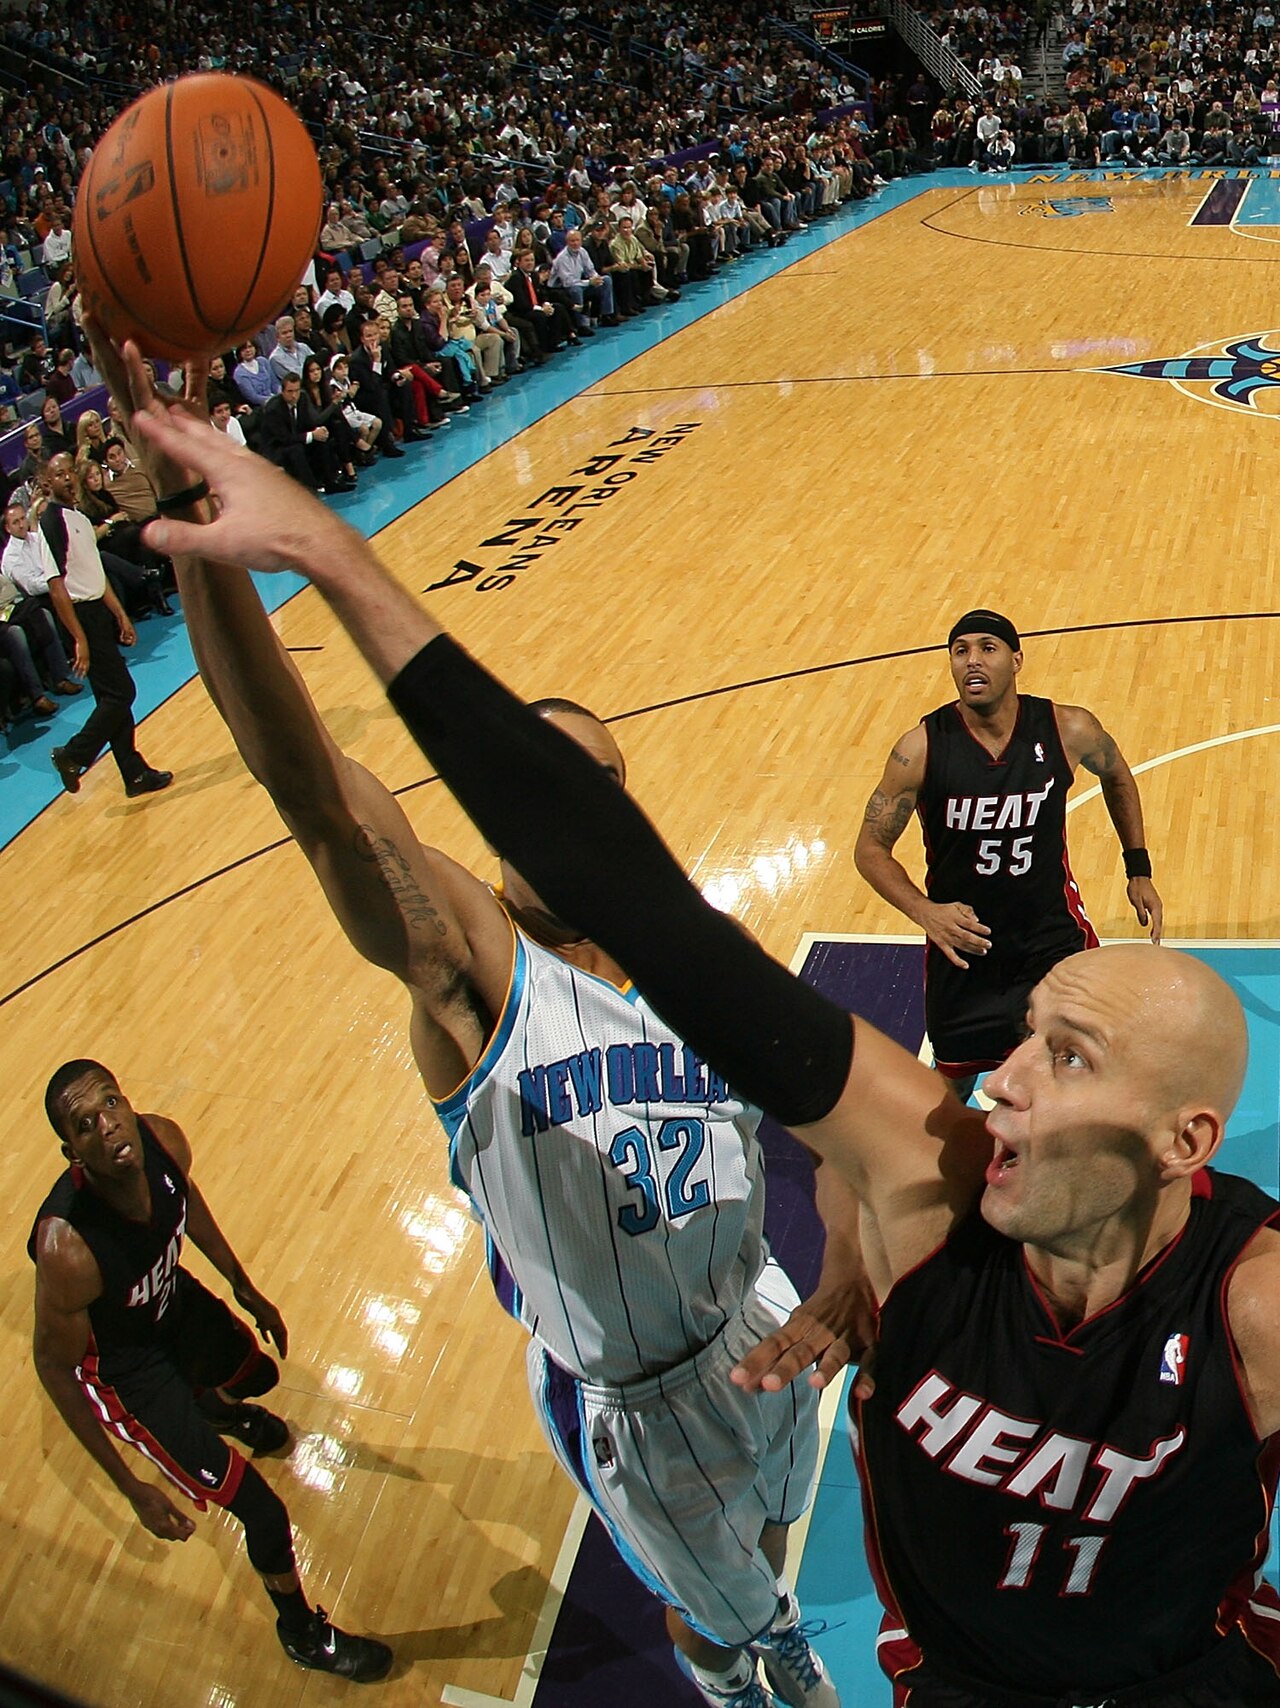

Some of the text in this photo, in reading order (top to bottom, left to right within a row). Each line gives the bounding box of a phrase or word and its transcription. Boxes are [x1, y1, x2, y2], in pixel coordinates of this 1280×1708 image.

[1024, 171, 1143, 184] NEW
[421, 426, 656, 594] ARENA
[475, 422, 703, 592] NEW ORLEANS
[946, 777, 1055, 831] HEAT
[976, 835, 1033, 876] 55
[518, 1041, 730, 1137] NEW ORLEA
[609, 1116, 712, 1237] 32
[893, 1369, 1188, 1523] HEAT
[997, 1520, 1111, 1597] 11
